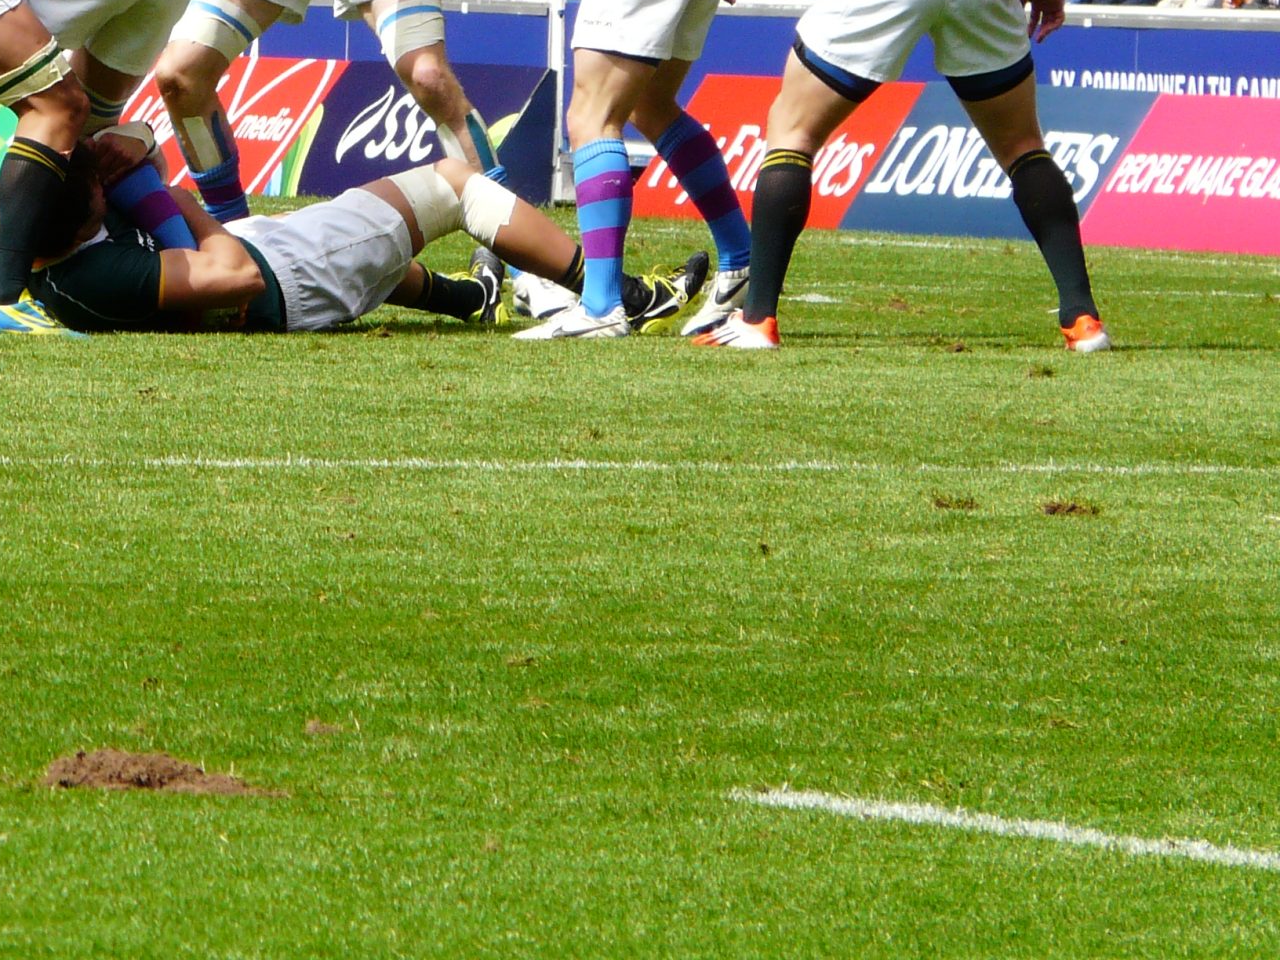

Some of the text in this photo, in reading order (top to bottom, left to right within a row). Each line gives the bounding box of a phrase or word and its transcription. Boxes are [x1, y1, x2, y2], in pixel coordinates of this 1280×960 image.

[233, 107, 294, 141] media
[1106, 154, 1192, 194] PEOPLE
[1177, 155, 1253, 197] MAKE
